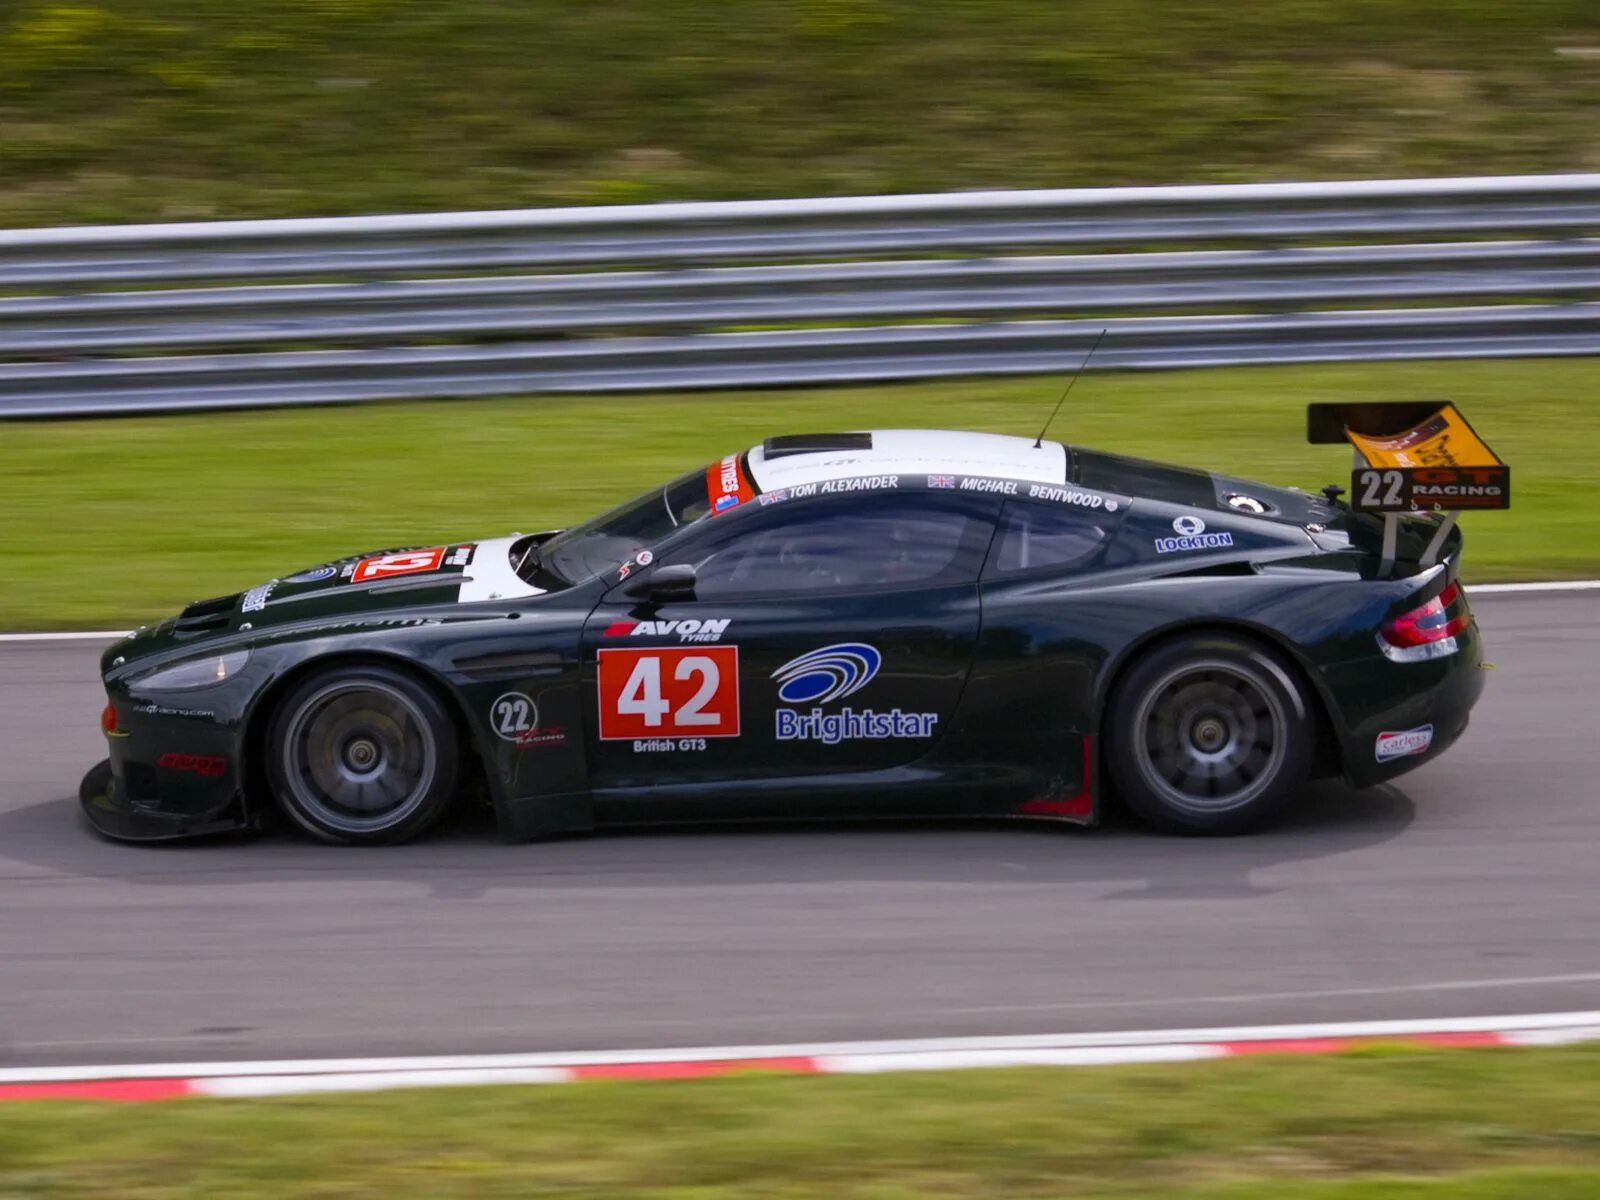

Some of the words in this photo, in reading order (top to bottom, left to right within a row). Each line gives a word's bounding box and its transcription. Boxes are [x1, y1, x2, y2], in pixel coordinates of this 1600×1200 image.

[790, 484, 817, 499] TOM
[821, 475, 899, 494] ALEXANDER
[960, 477, 1018, 495] MICHAEL
[1029, 485, 1103, 508] BENTWOOD
[1360, 471, 1403, 507] 22
[1412, 485, 1501, 496] RACING
[1155, 532, 1234, 554] LOCKTON
[630, 618, 732, 636] AVON
[679, 633, 722, 643] TYRES
[617, 656, 721, 727] 42
[498, 699, 530, 734] 22
[776, 707, 938, 744] Brightstar
[633, 740, 676, 753] British
[678, 739, 707, 752] GT3
